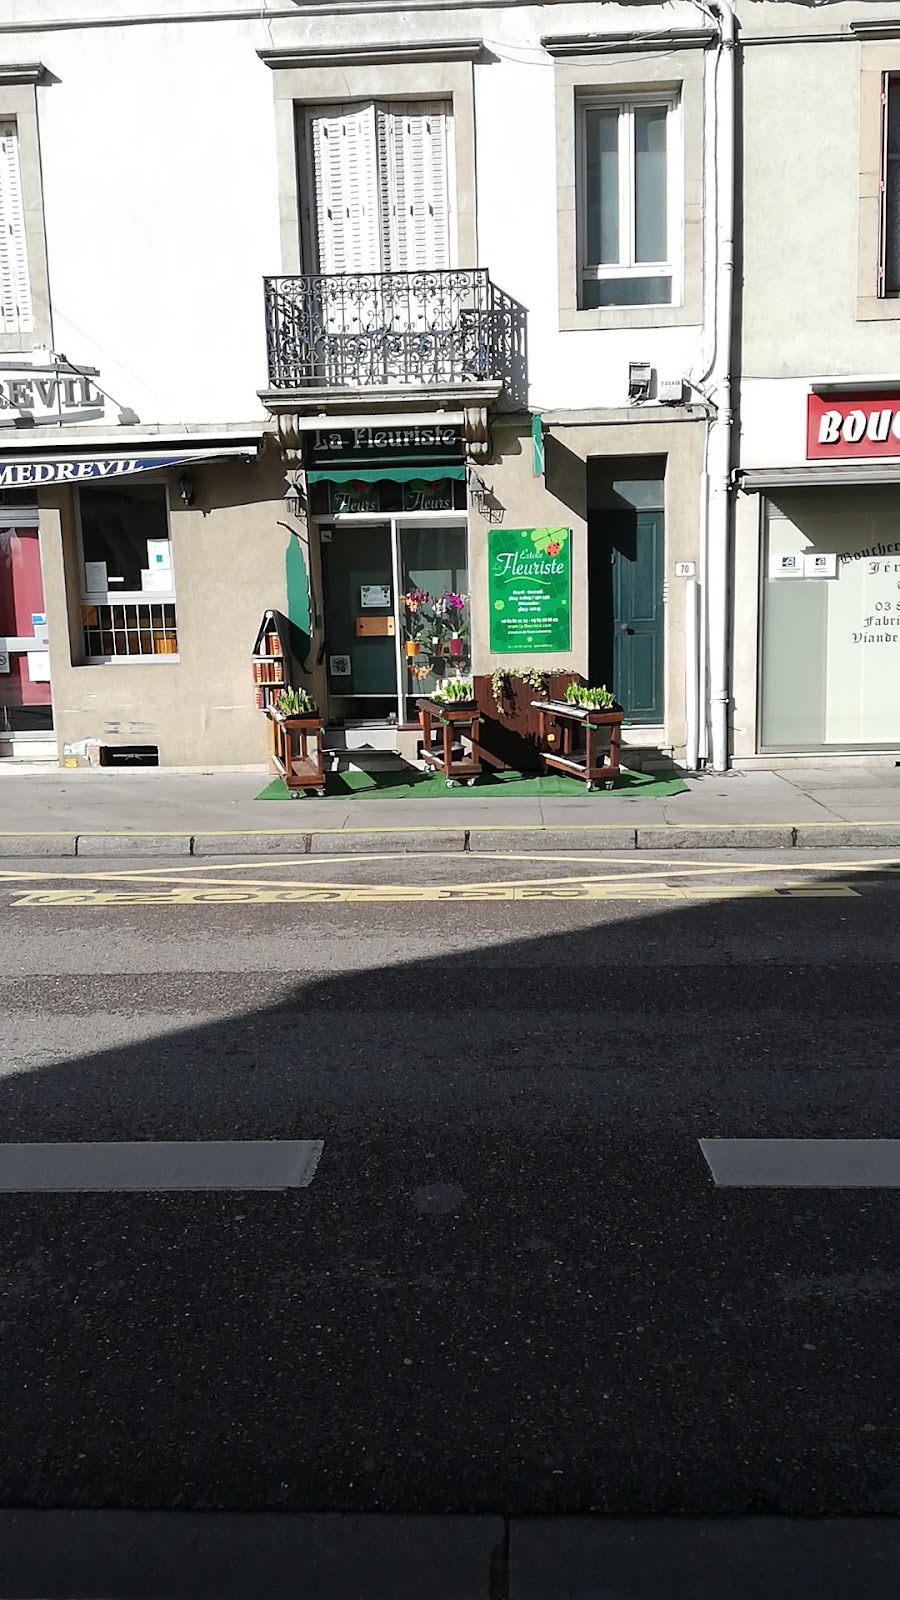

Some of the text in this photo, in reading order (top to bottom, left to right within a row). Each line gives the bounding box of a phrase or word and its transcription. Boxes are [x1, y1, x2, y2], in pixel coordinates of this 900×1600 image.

[313, 425, 456, 450] La Fleuriste
[333, 492, 376, 513] Fleurs
[406, 490, 450, 510] Fleurs
[494, 551, 564, 576] Fleuriste
[680, 564, 690, 573] 70
[875, 601, 891, 611] 03
